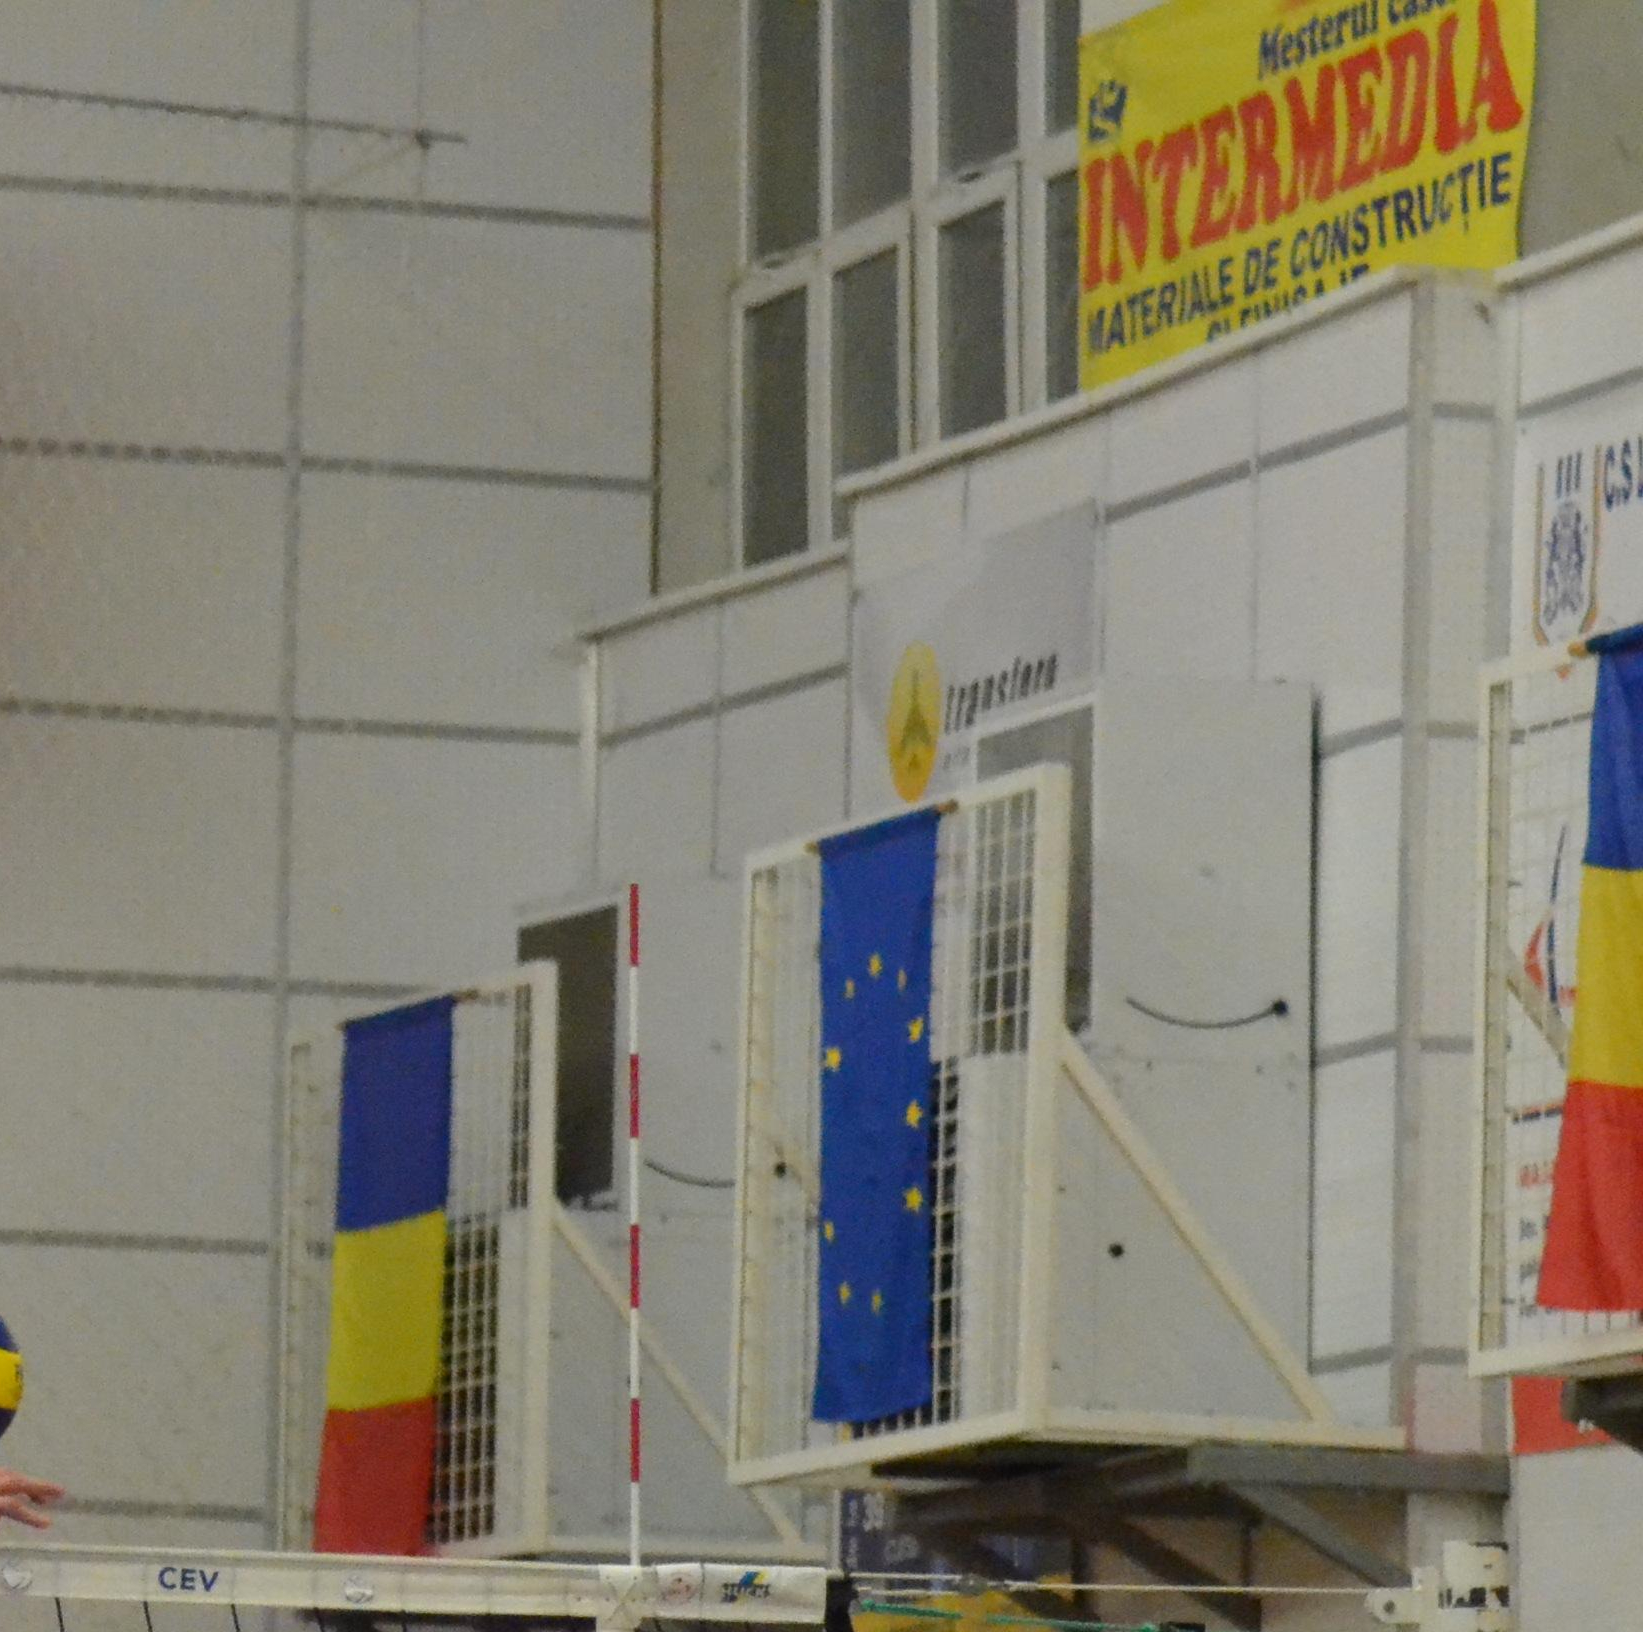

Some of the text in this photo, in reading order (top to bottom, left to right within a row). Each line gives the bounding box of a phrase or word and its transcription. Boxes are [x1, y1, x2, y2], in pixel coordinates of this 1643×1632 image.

[1082, 0, 1524, 292] INTERMEDIA
[1087, 256, 1233, 355] MATERIALE
[1244, 238, 1282, 297] DE
[158, 1566, 220, 1592] CEV
